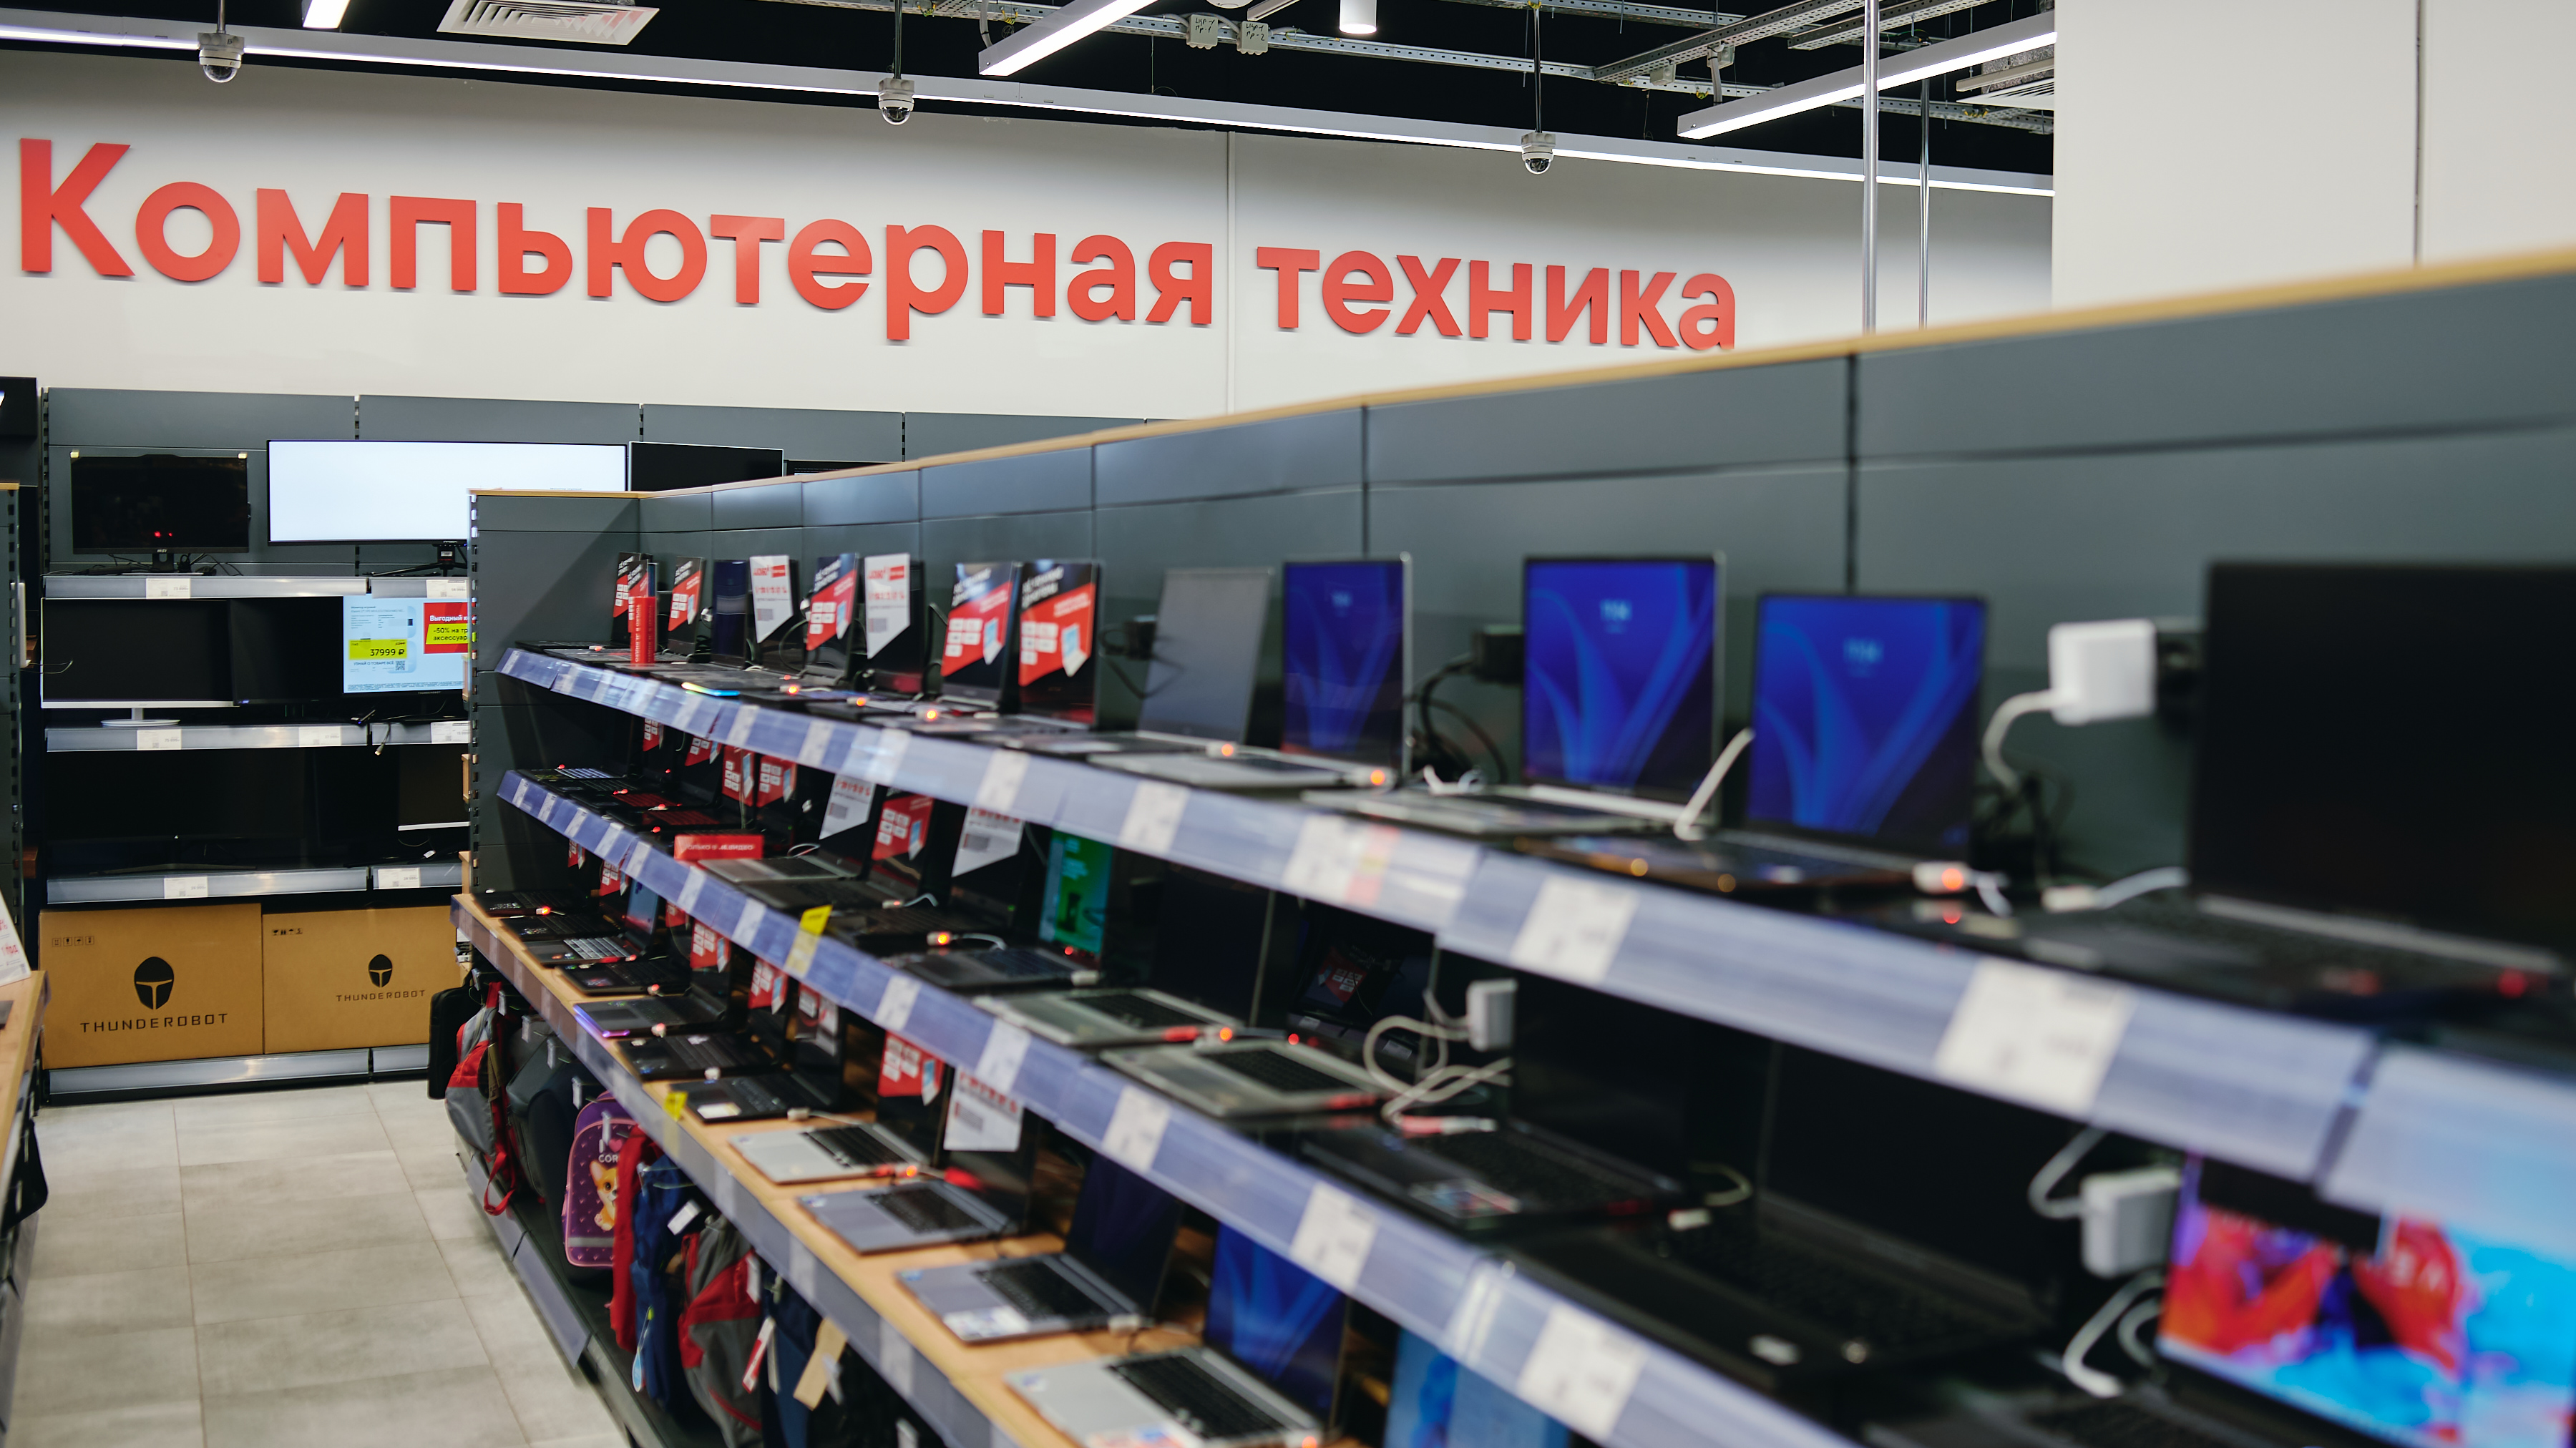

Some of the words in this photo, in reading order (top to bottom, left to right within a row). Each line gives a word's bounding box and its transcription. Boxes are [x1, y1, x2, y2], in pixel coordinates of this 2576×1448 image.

[19, 137, 1214, 342] Компьютерная
[1257, 245, 1735, 350] техника
[370, 648, 396, 657] 37999
[336, 989, 426, 1002] THUNDEROBOT
[80, 1013, 228, 1033] THUNDEROBOT
